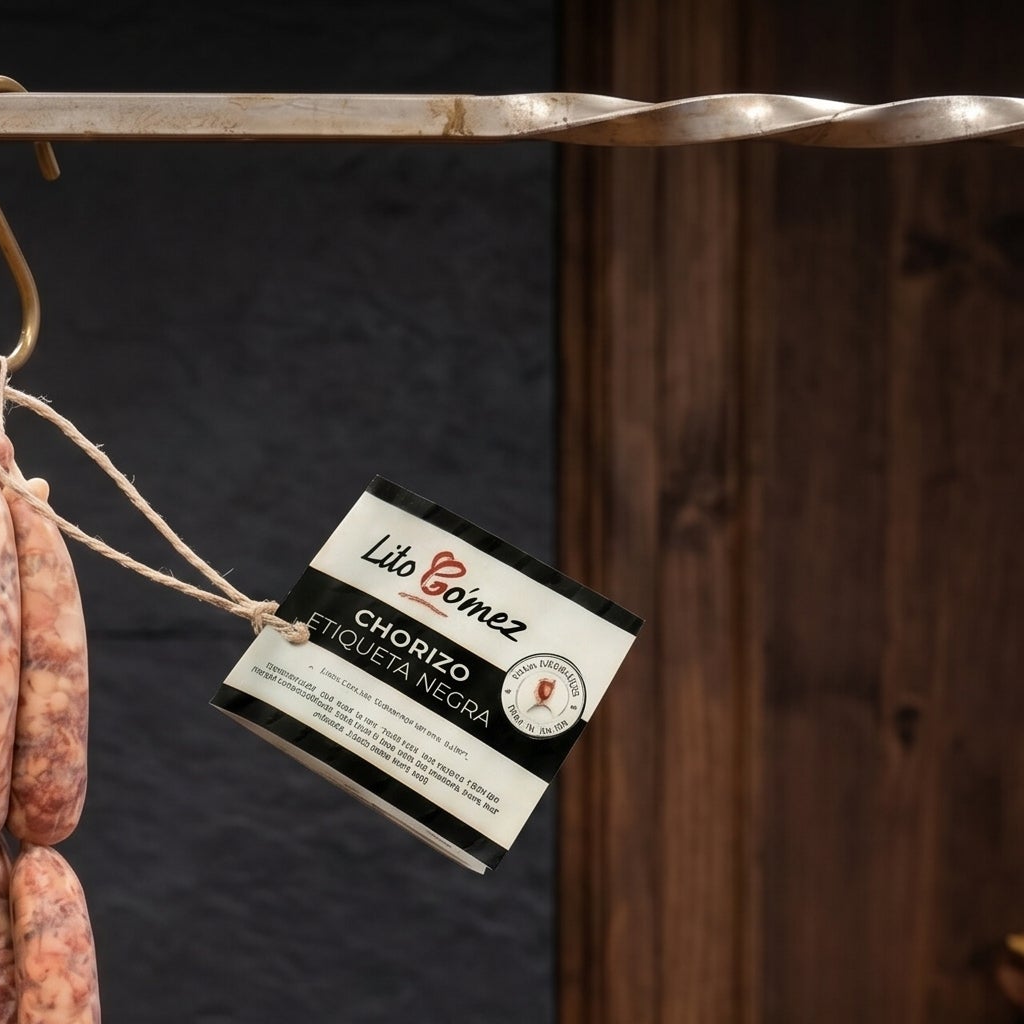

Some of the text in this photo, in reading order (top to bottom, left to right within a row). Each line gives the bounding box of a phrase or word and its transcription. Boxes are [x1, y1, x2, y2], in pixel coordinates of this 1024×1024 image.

[361, 534, 416, 577] Lito
[306, 611, 410, 681] ETIQUETA
[416, 672, 490, 728] NEGRA
[354, 609, 470, 682] CHORIZO
